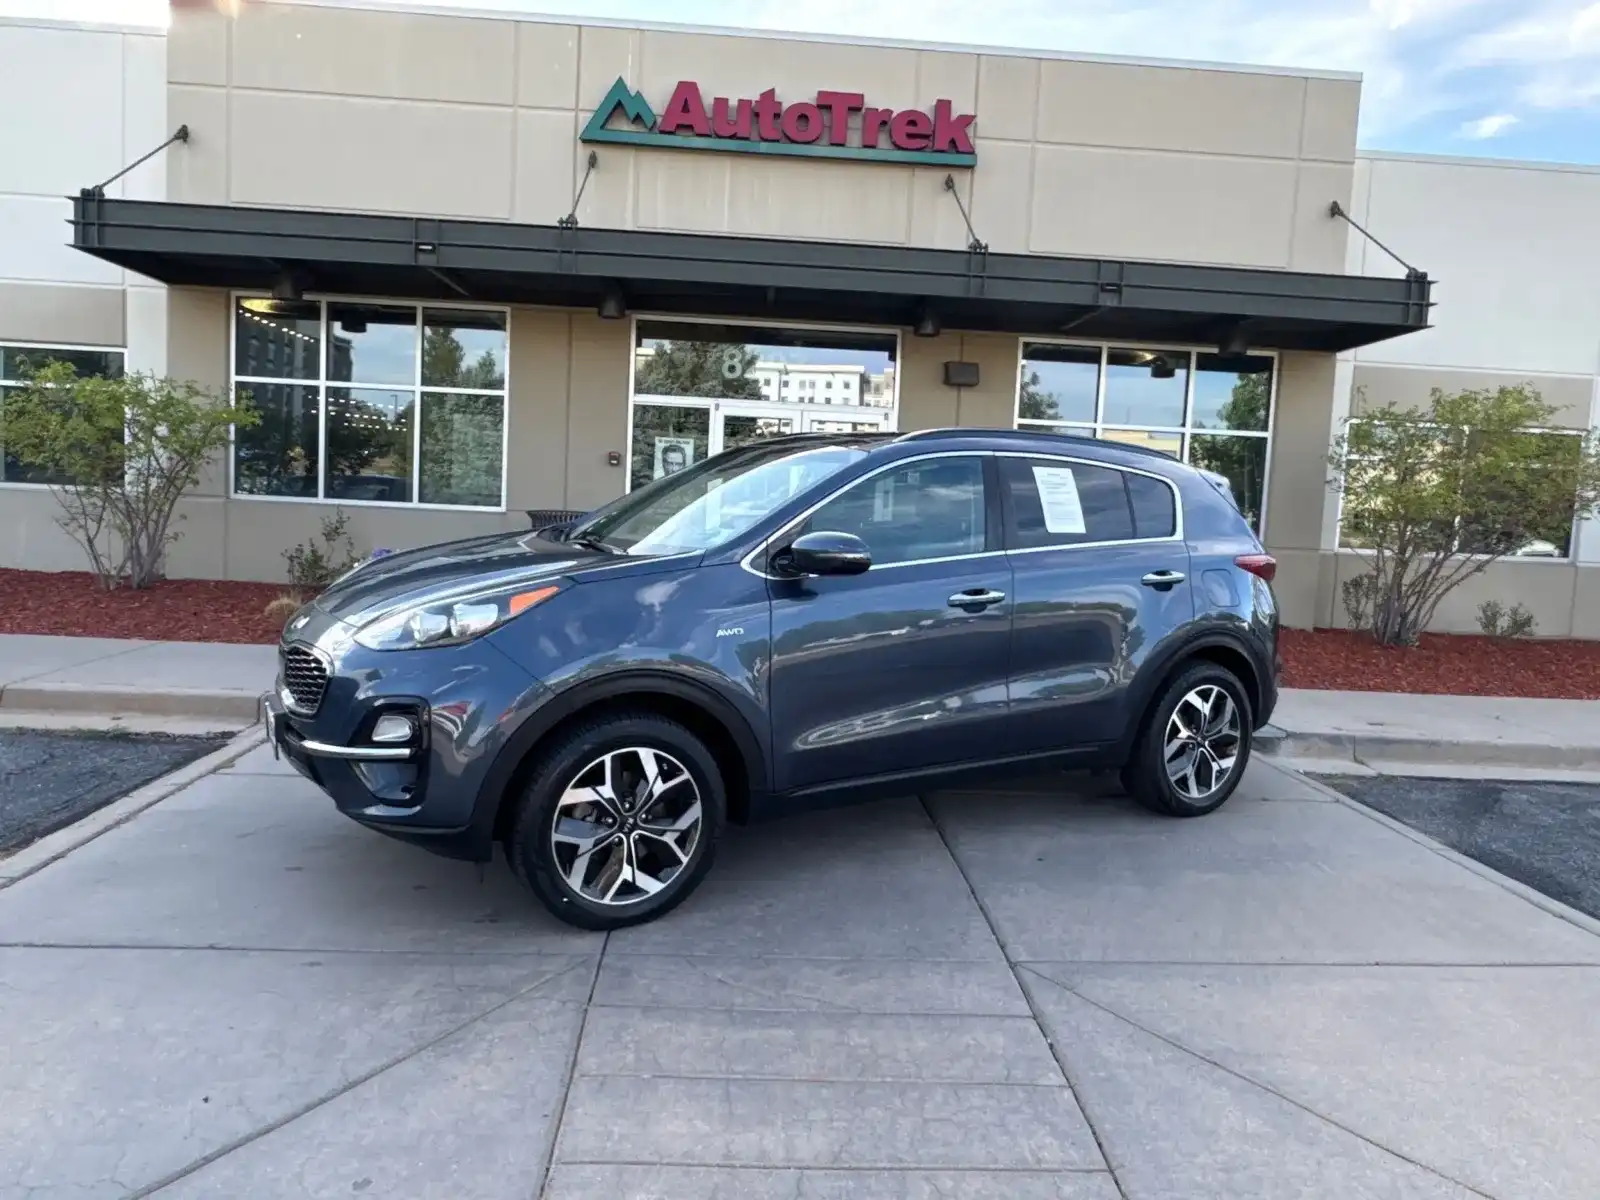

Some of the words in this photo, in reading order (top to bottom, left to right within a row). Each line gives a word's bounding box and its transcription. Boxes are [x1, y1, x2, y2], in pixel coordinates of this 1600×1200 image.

[658, 81, 977, 153] AutoTrek
[722, 349, 742, 379] 8
[716, 627, 744, 638] AWD
